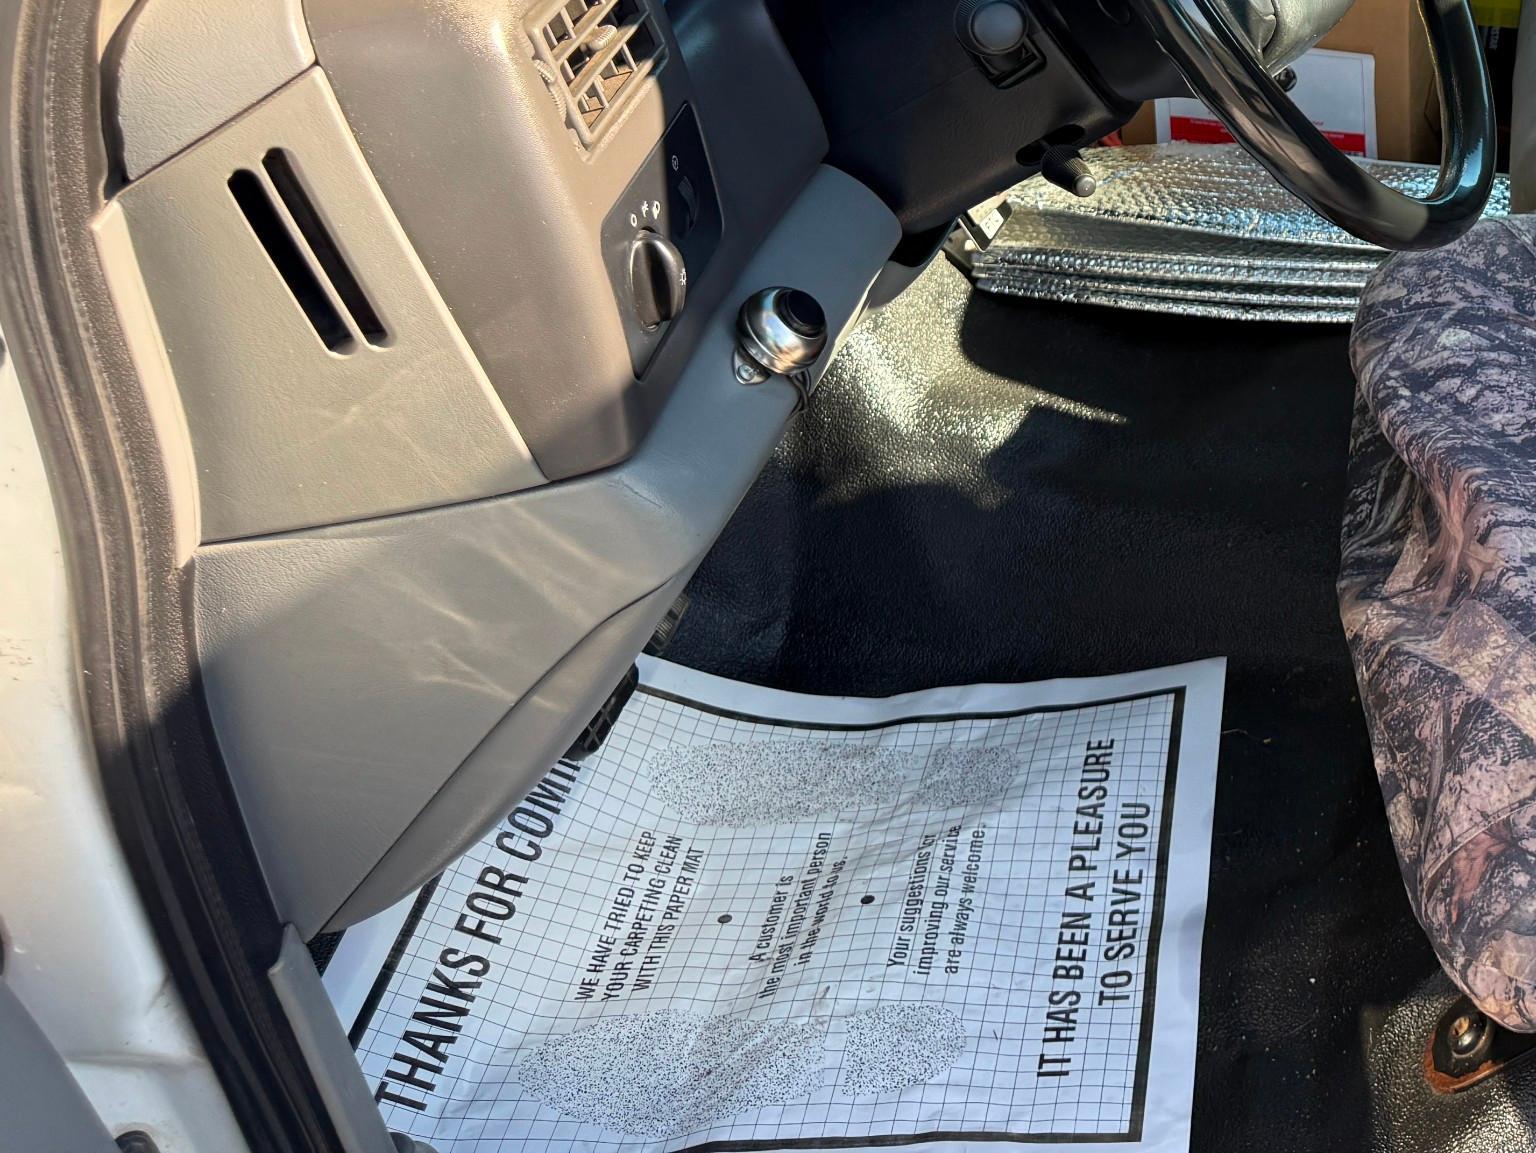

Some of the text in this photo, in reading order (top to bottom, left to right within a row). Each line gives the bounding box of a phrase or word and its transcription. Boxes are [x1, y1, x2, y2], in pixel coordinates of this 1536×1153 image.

[575, 831, 657, 1001] WE HAVE TRIED TO KEEP
[601, 835, 683, 1002] YOUR CARPETING CLEAN
[632, 846, 705, 992] WITH THIS PAPER MAT
[749, 874, 794, 962] A customer is
[758, 832, 831, 999] the most important person
[800, 927, 821, 949] the
[811, 889, 834, 927] world
[822, 874, 839, 889] to
[886, 936, 911, 968] Your
[900, 850, 932, 932] suggestions
[913, 825, 962, 976] improving our service
[948, 897, 975, 946] always
[1037, 737, 1115, 1078] IT HAS BEEN A PLEASURE
[1098, 801, 1152, 1007] TO SERVE YOU
[374, 948, 491, 1111] THANKS
[455, 865, 530, 945] FOR
[793, 952, 812, 967] in
[945, 949, 962, 974] are
